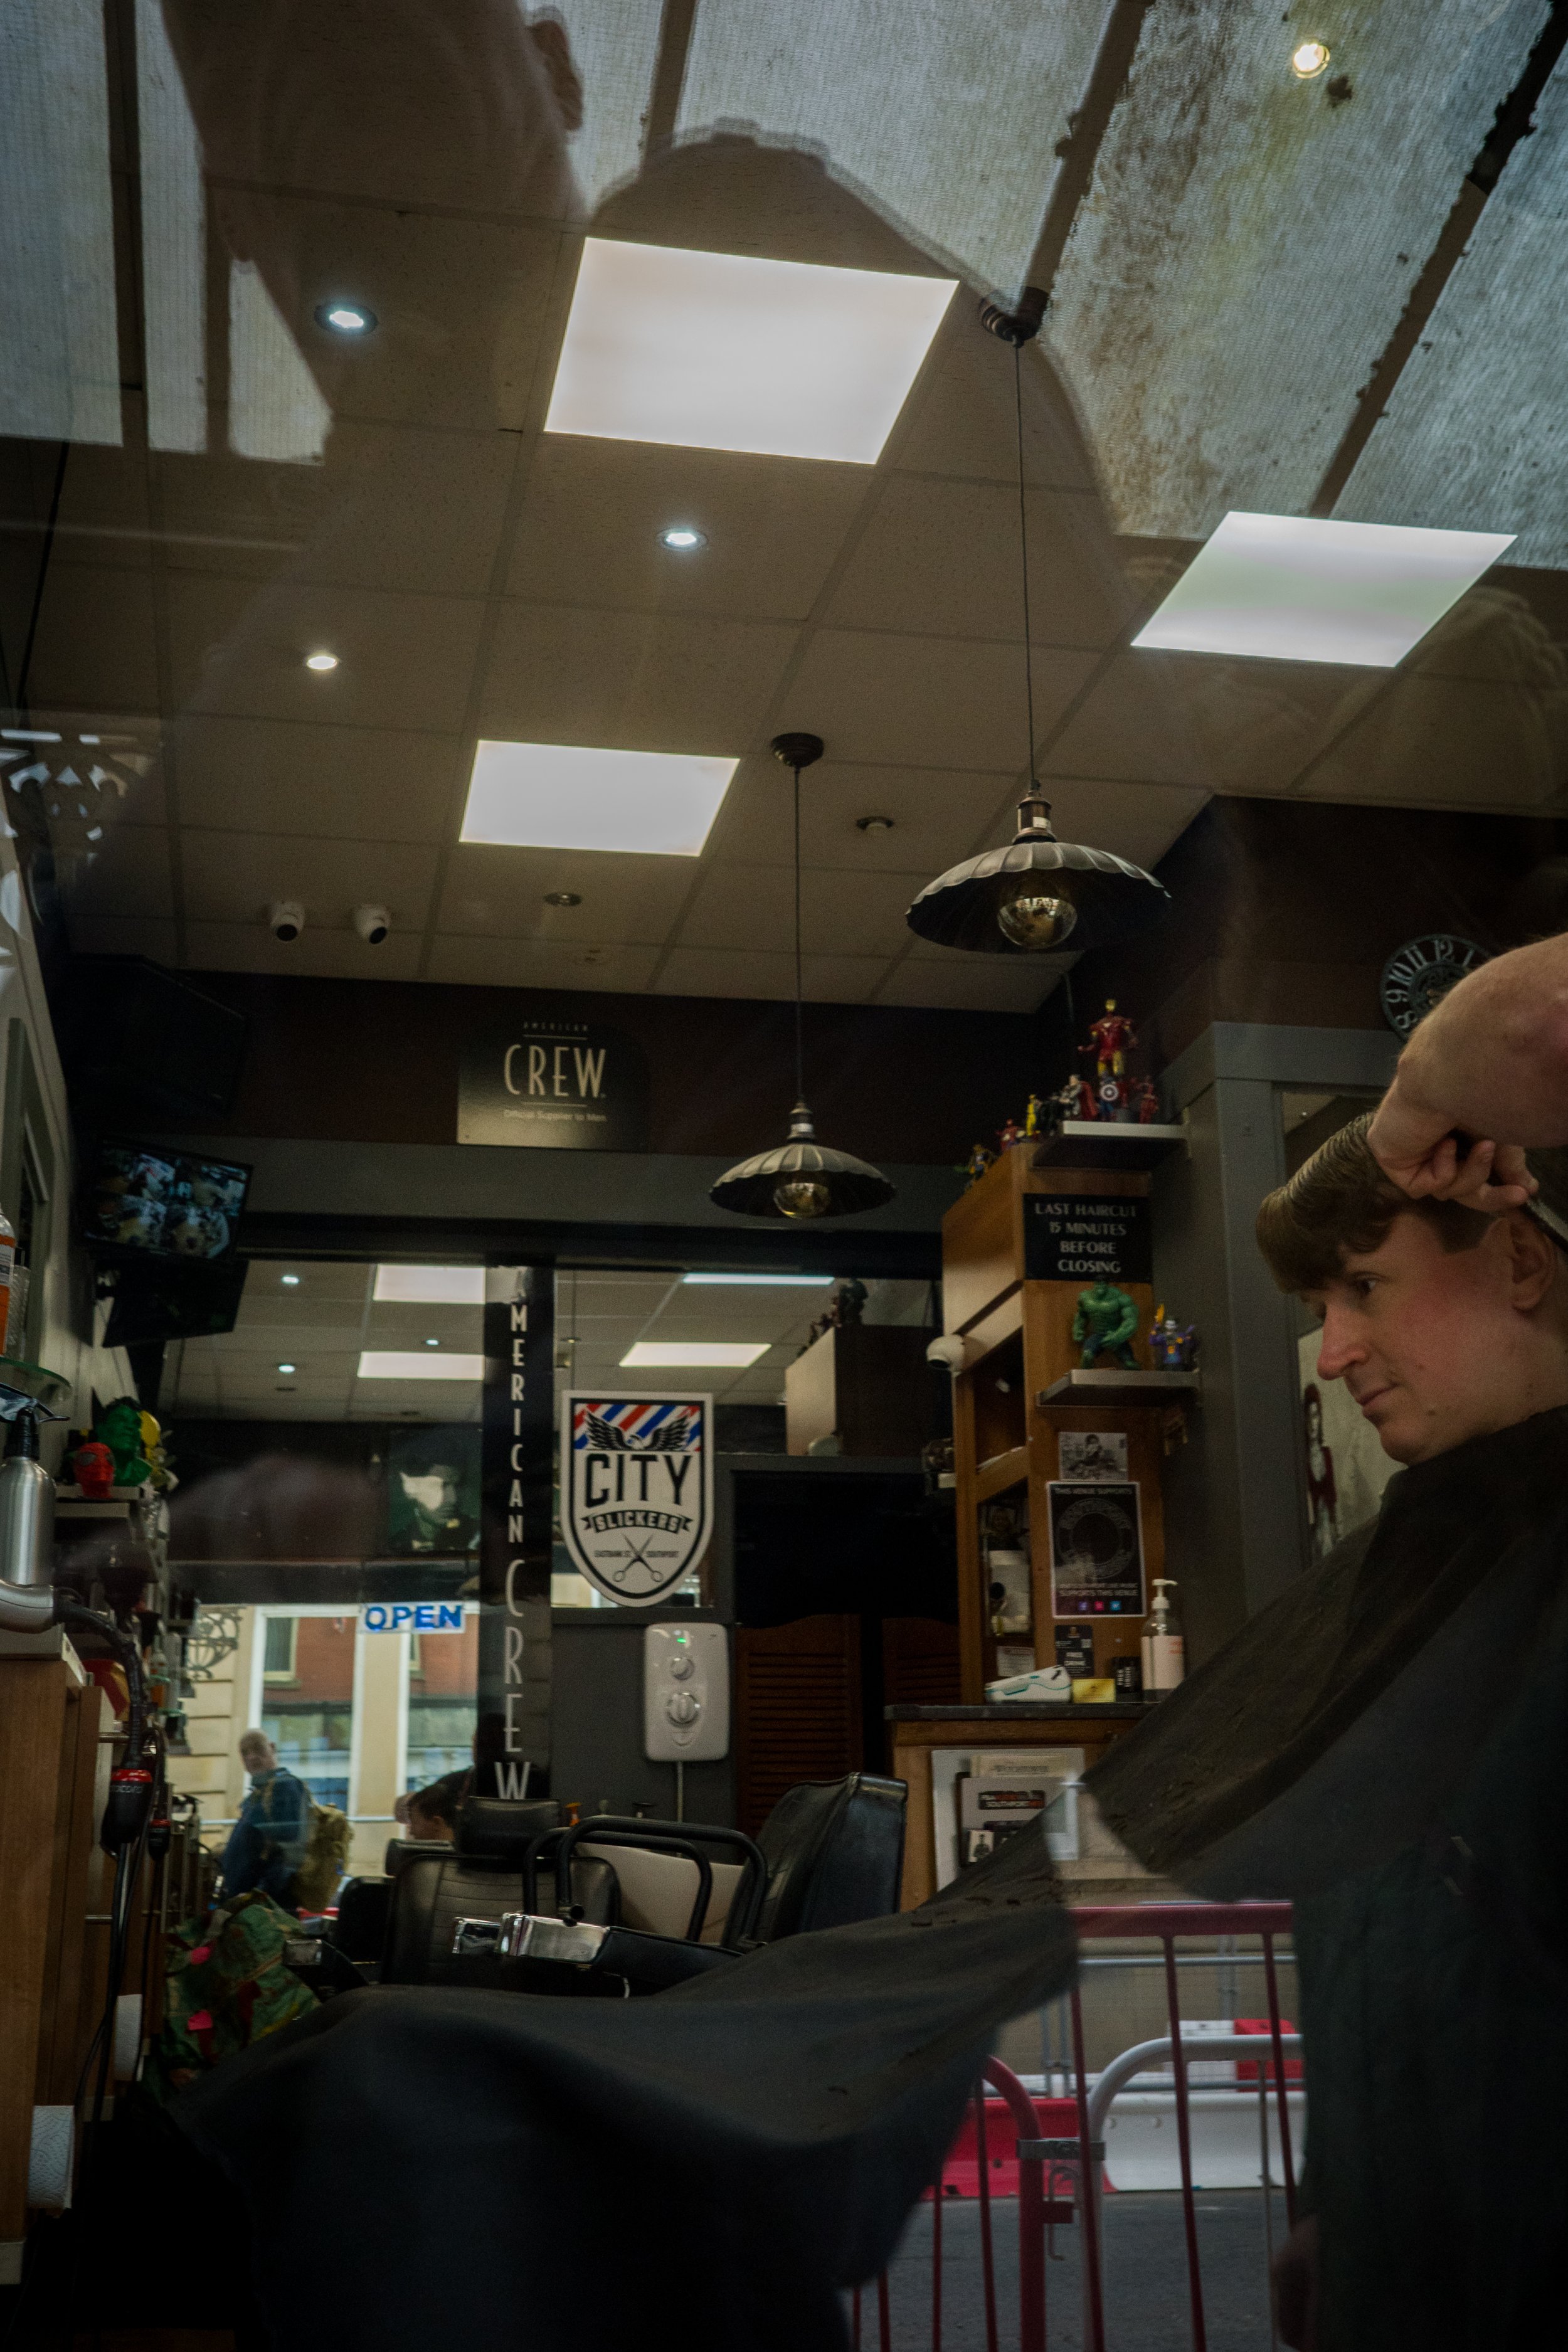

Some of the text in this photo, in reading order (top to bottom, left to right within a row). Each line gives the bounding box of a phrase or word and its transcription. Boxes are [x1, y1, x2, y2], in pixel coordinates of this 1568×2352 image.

[504, 1044, 606, 1098] CREW
[1035, 1203, 1136, 1217] LAST HAIRCUT
[1049, 1221, 1127, 1236] 15 MINUTES
[1059, 1240, 1116, 1254] BEFORE
[1057, 1259, 1121, 1273] CLOSING
[586, 1453, 692, 1508] CITY
[595, 1512, 680, 1531] SLICKERS
[366, 1605, 463, 1631] OPEN
[494, 1559, 531, 1799] CREW
